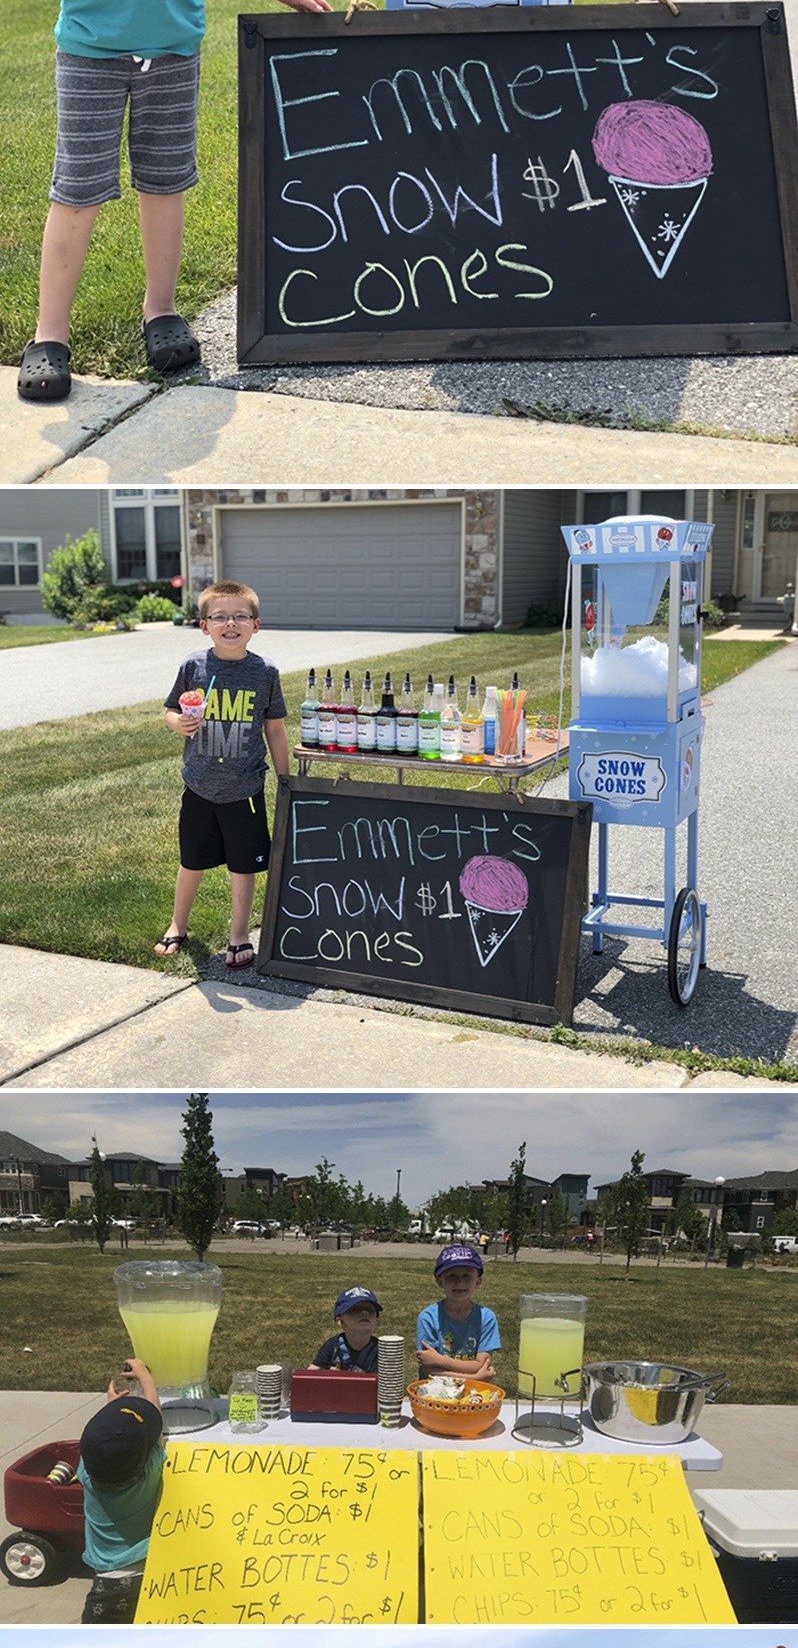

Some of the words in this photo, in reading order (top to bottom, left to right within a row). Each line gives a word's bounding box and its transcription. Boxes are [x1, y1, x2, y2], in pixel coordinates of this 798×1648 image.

[269, 32, 719, 160] Emmett's
[521, 149, 607, 212] $1
[598, 759, 645, 777] SNOW
[594, 777, 646, 795] CONES
[292, 800, 541, 866] Emmett's
[415, 881, 462, 919] $1
[342, 1452, 387, 1479] 75¢
[389, 1468, 410, 1481] or
[290, 1480, 309, 1500] 2
[321, 1480, 348, 1499] for
[356, 1482, 378, 1500] $1
[528, 1491, 546, 1504] or
[566, 1488, 582, 1511] 2
[595, 1490, 619, 1511] for
[158, 1503, 215, 1538] CANS
[231, 1504, 258, 1526] of
[265, 1502, 340, 1526] SODA:
[349, 1502, 373, 1523] $1
[441, 1510, 523, 1542] CANS
[537, 1511, 559, 1538] of
[279, 1528, 326, 1546] Croix
[149, 1562, 225, 1599] WATER
[365, 1550, 391, 1581] $1
[448, 1551, 540, 1580] WATER
[546, 1583, 582, 1614] 75¢
[599, 1597, 616, 1612] or
[625, 1585, 647, 1612] 2
[650, 1599, 673, 1612] for
